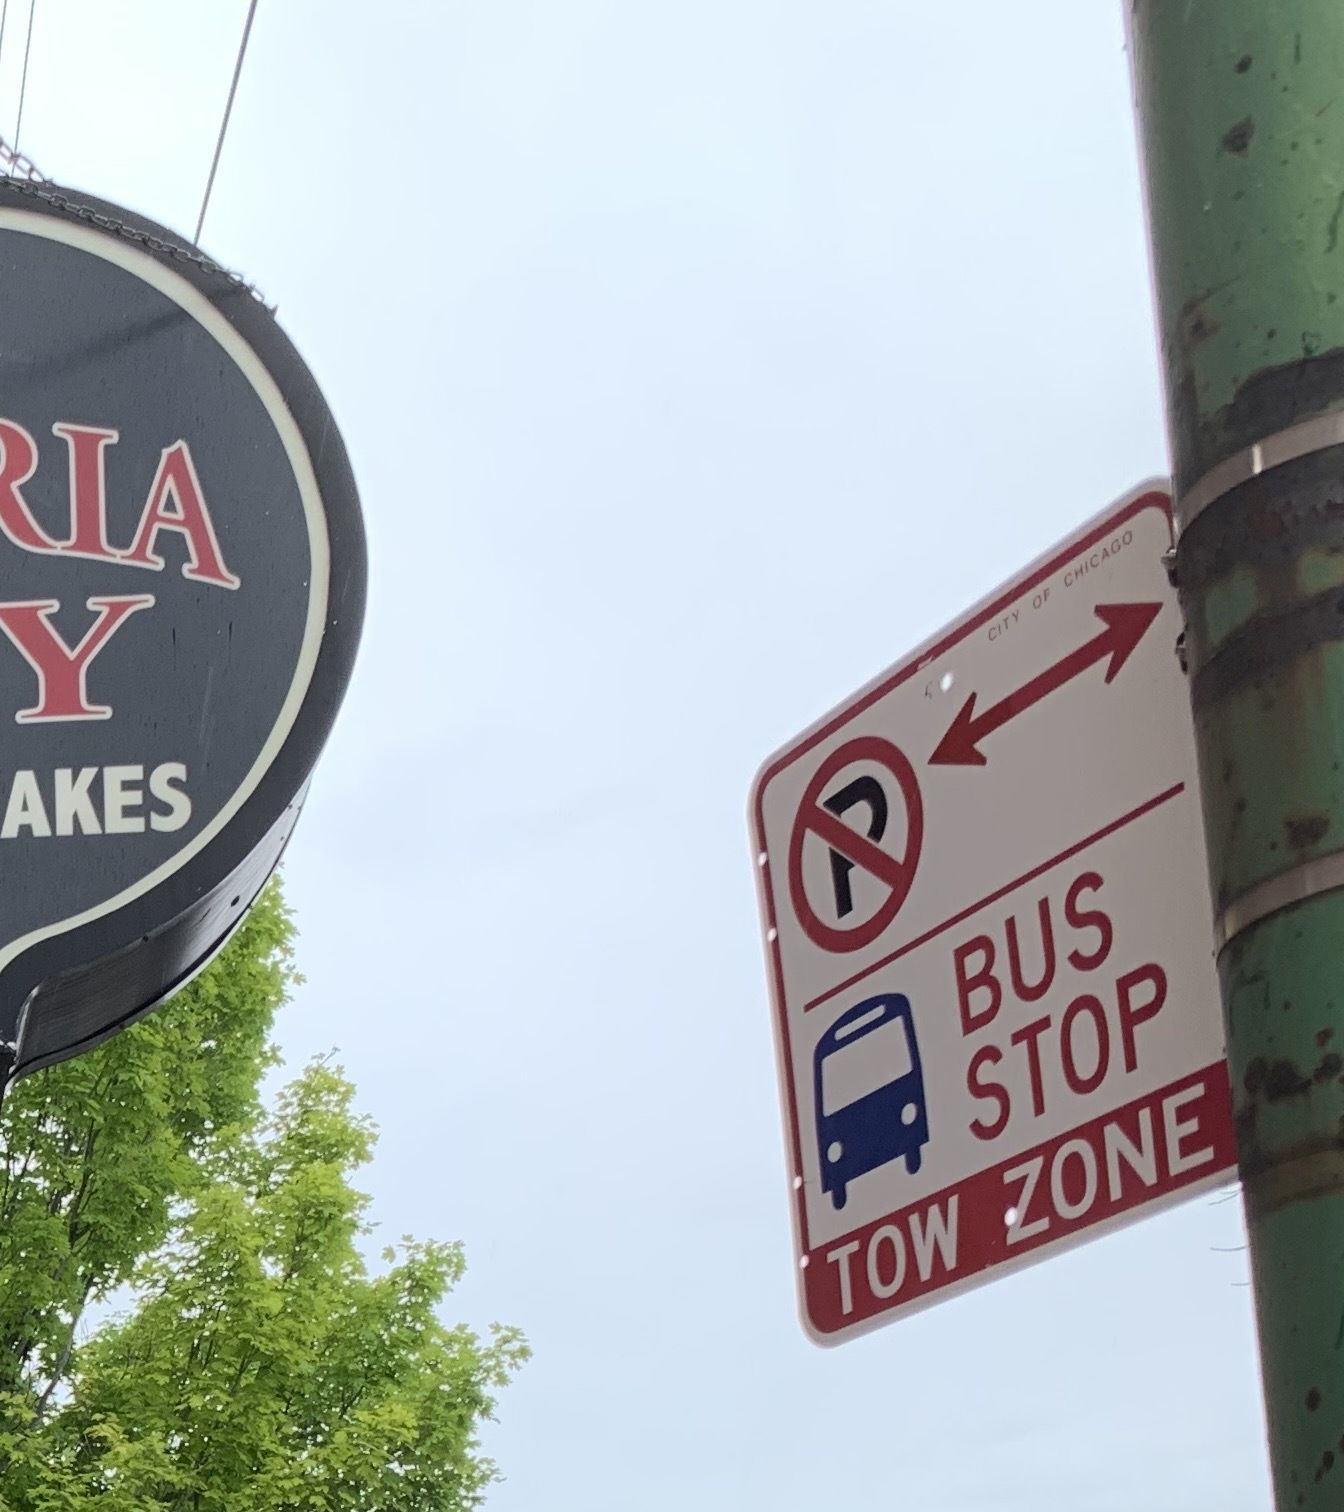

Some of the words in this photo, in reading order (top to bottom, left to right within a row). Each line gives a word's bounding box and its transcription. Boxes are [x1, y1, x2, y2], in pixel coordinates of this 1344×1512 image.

[988, 610, 1020, 641] CITY
[1032, 588, 1051, 609] OF
[1064, 530, 1133, 588] CHICAGO
[953, 870, 1114, 1037] BUS
[967, 962, 1168, 1142] STOP
[827, 1195, 960, 1317] TOW
[1004, 1082, 1216, 1247] ZONE
